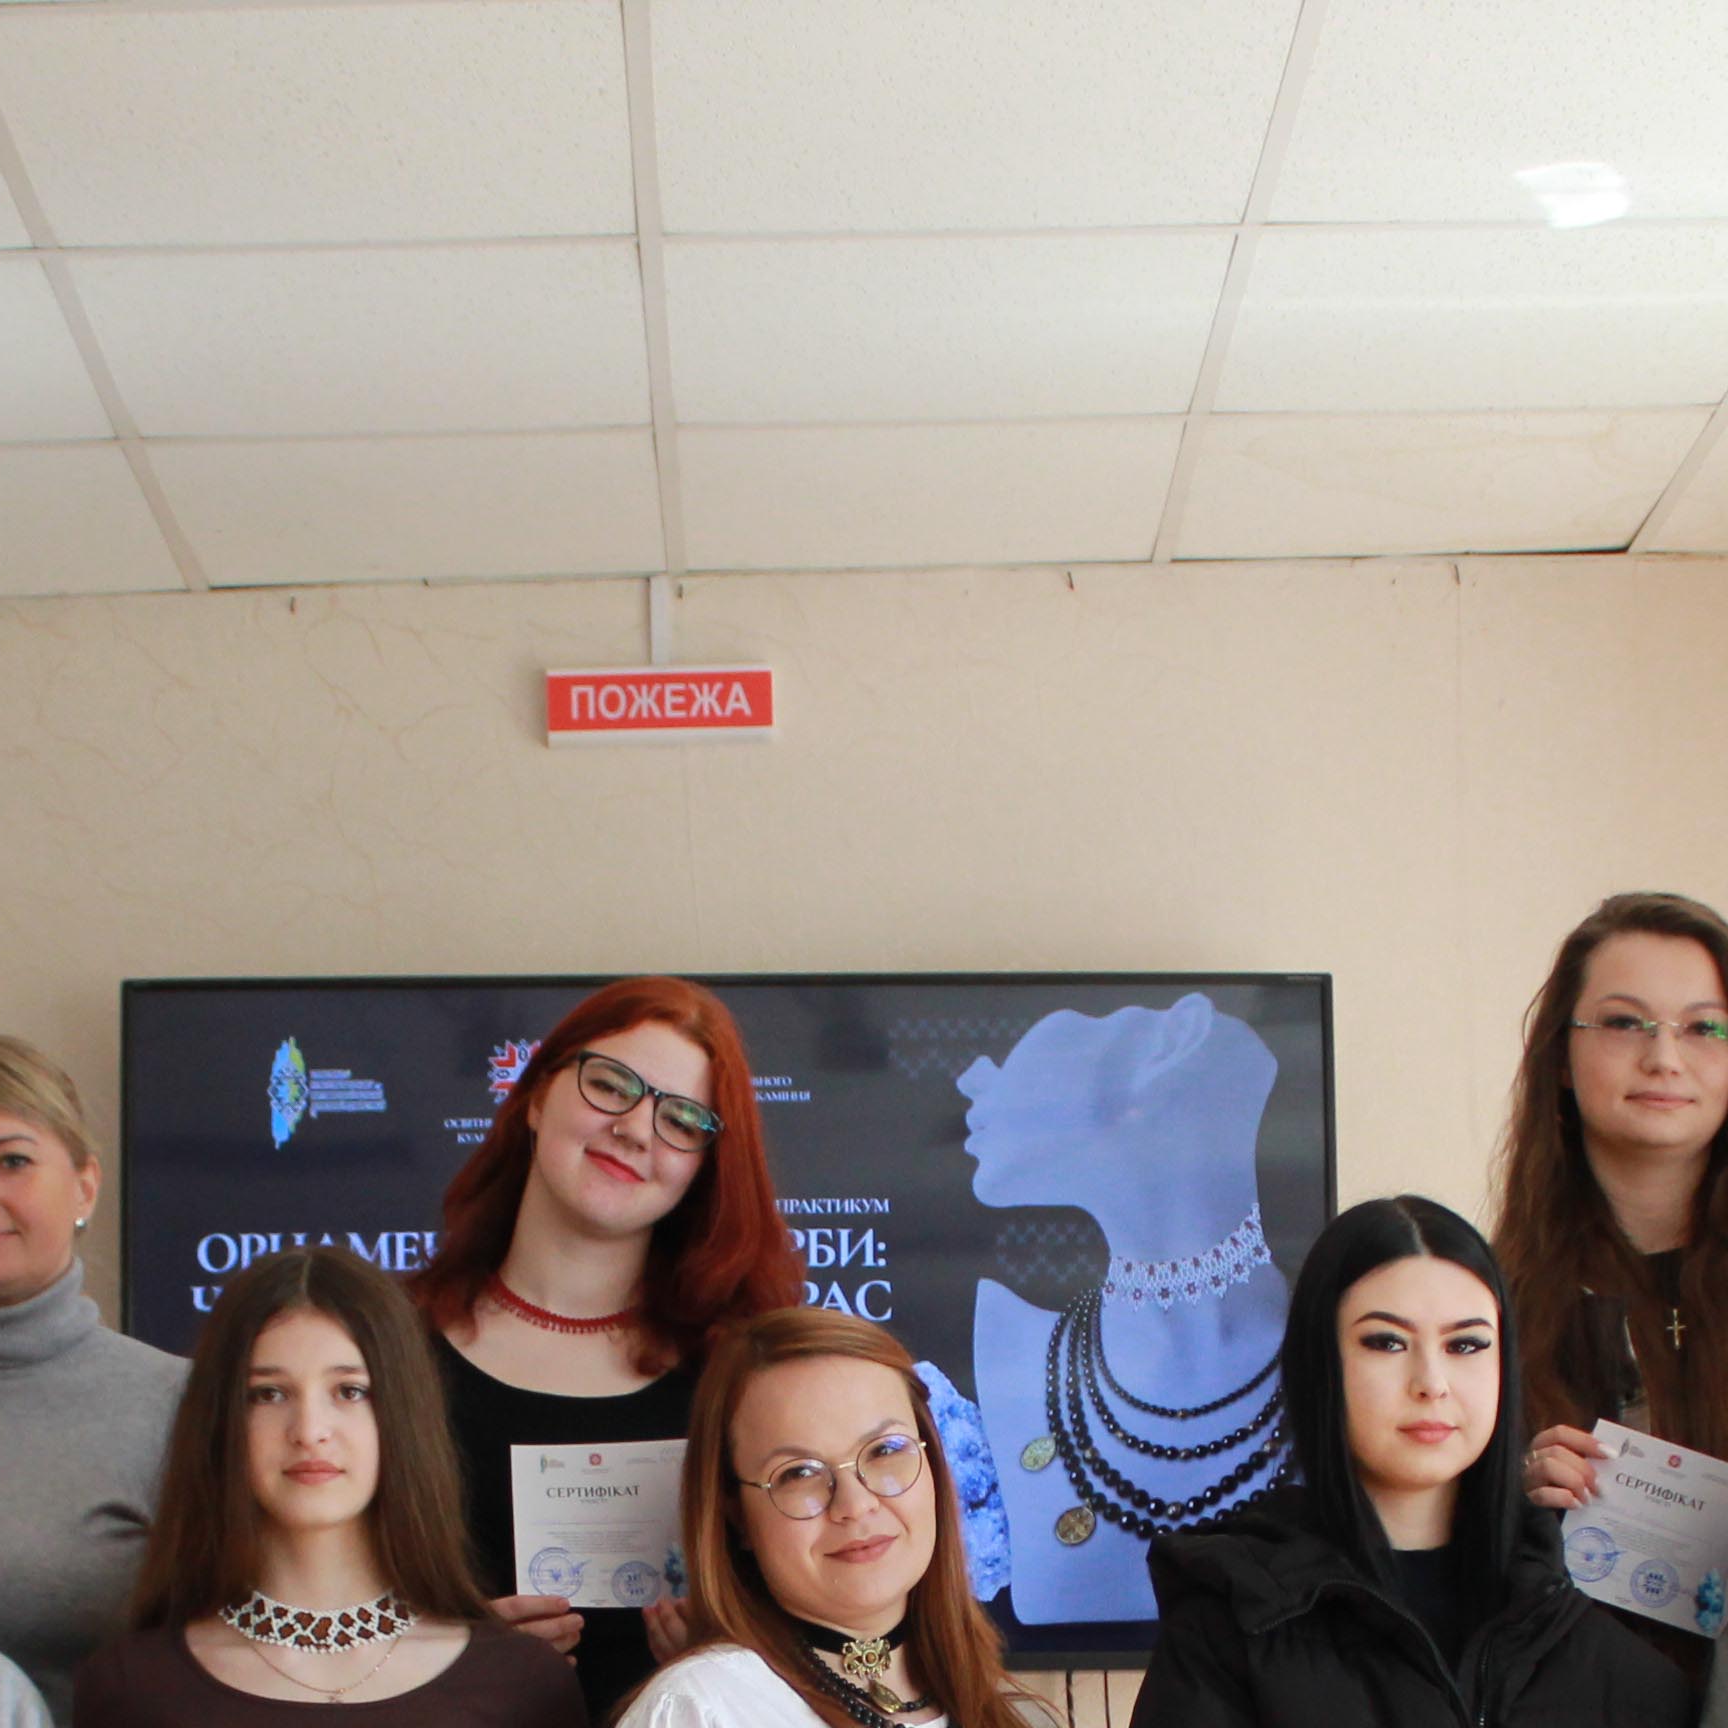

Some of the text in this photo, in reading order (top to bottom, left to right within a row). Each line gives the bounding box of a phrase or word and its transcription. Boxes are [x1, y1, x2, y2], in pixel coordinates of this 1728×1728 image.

[570, 682, 752, 721] ПОЖЕЖА
[546, 1485, 641, 1499] СЕРТИФІКАТ
[1615, 1472, 1706, 1512] СЕРТИФІКАТ
